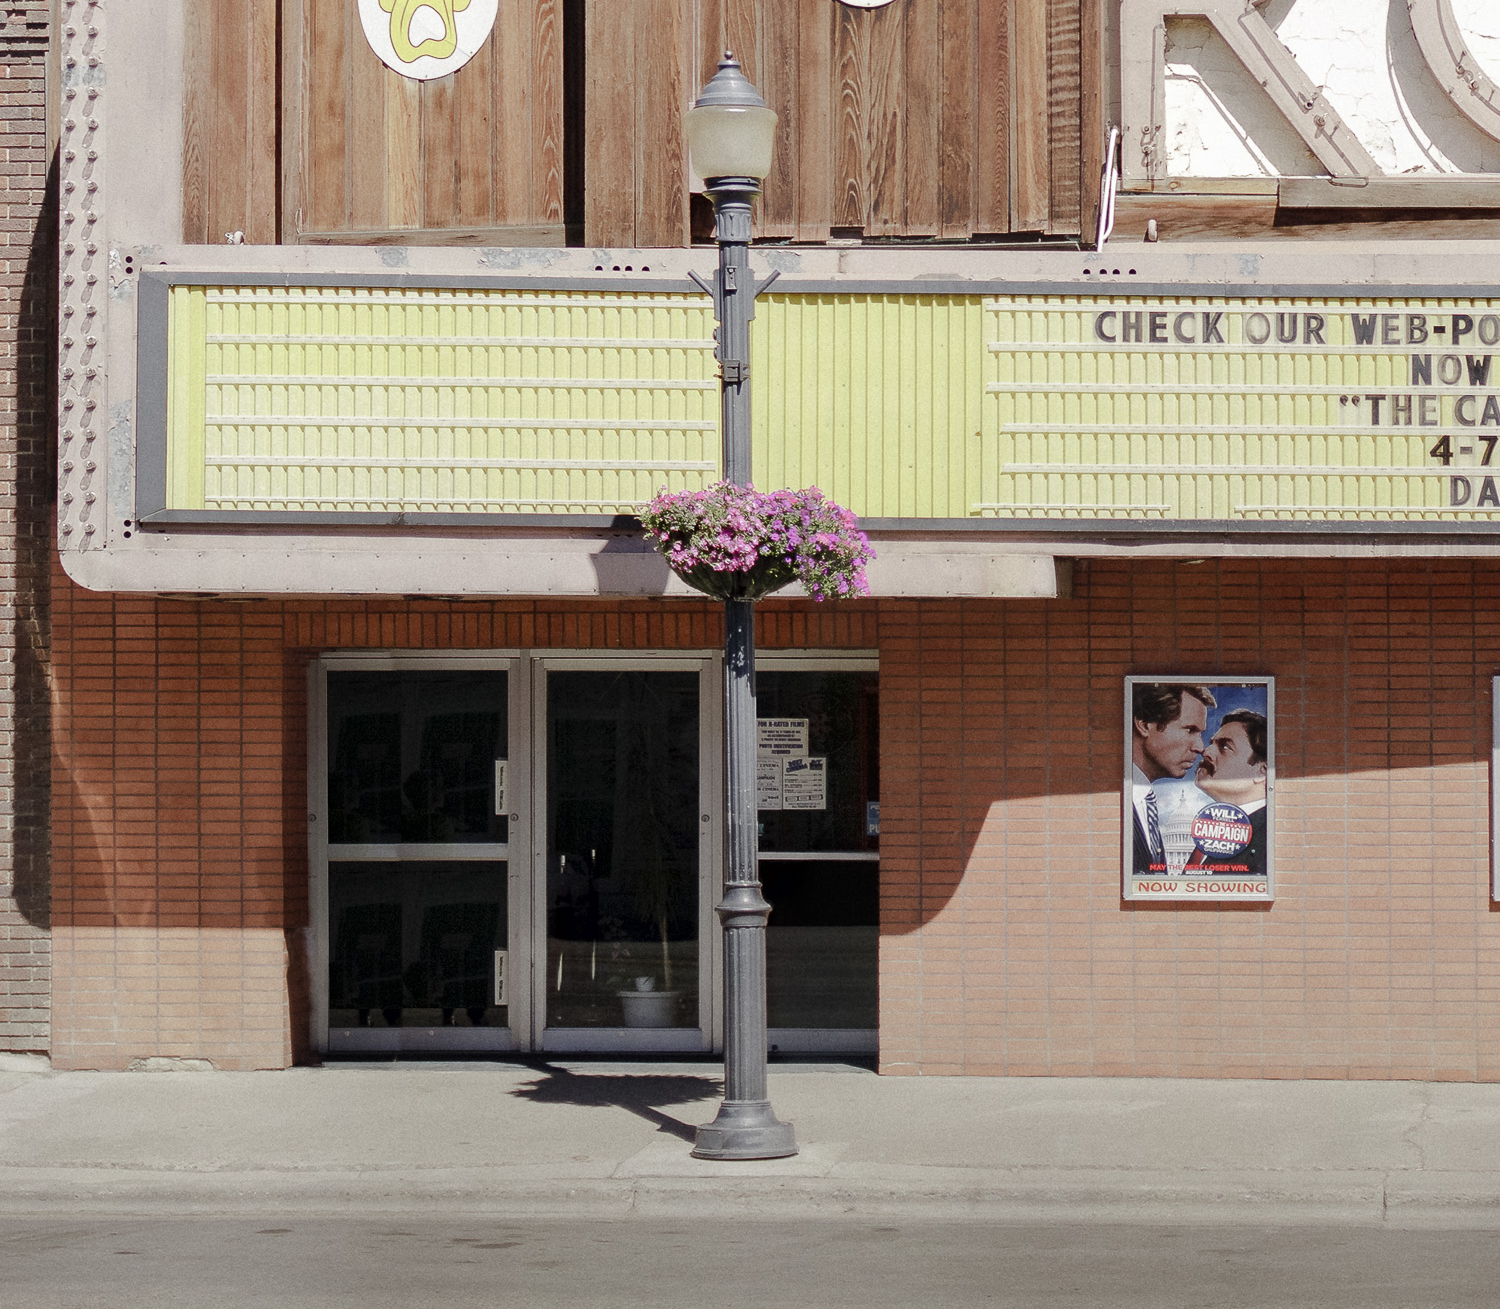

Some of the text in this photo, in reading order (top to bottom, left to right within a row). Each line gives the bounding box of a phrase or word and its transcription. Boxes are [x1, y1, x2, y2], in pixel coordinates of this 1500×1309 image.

[1095, 312, 1225, 345] CHECK
[1245, 313, 1326, 346] OUR
[1410, 355, 1493, 388] NOW
[1339, 395, 1438, 428] "THE
[1210, 807, 1238, 820] WILL
[1194, 822, 1249, 843] CAMPAIGN
[1203, 838, 1236, 851] ZACH
[1204, 864, 1230, 872] LOSER
[1138, 882, 1266, 893] NOW SHOWING
